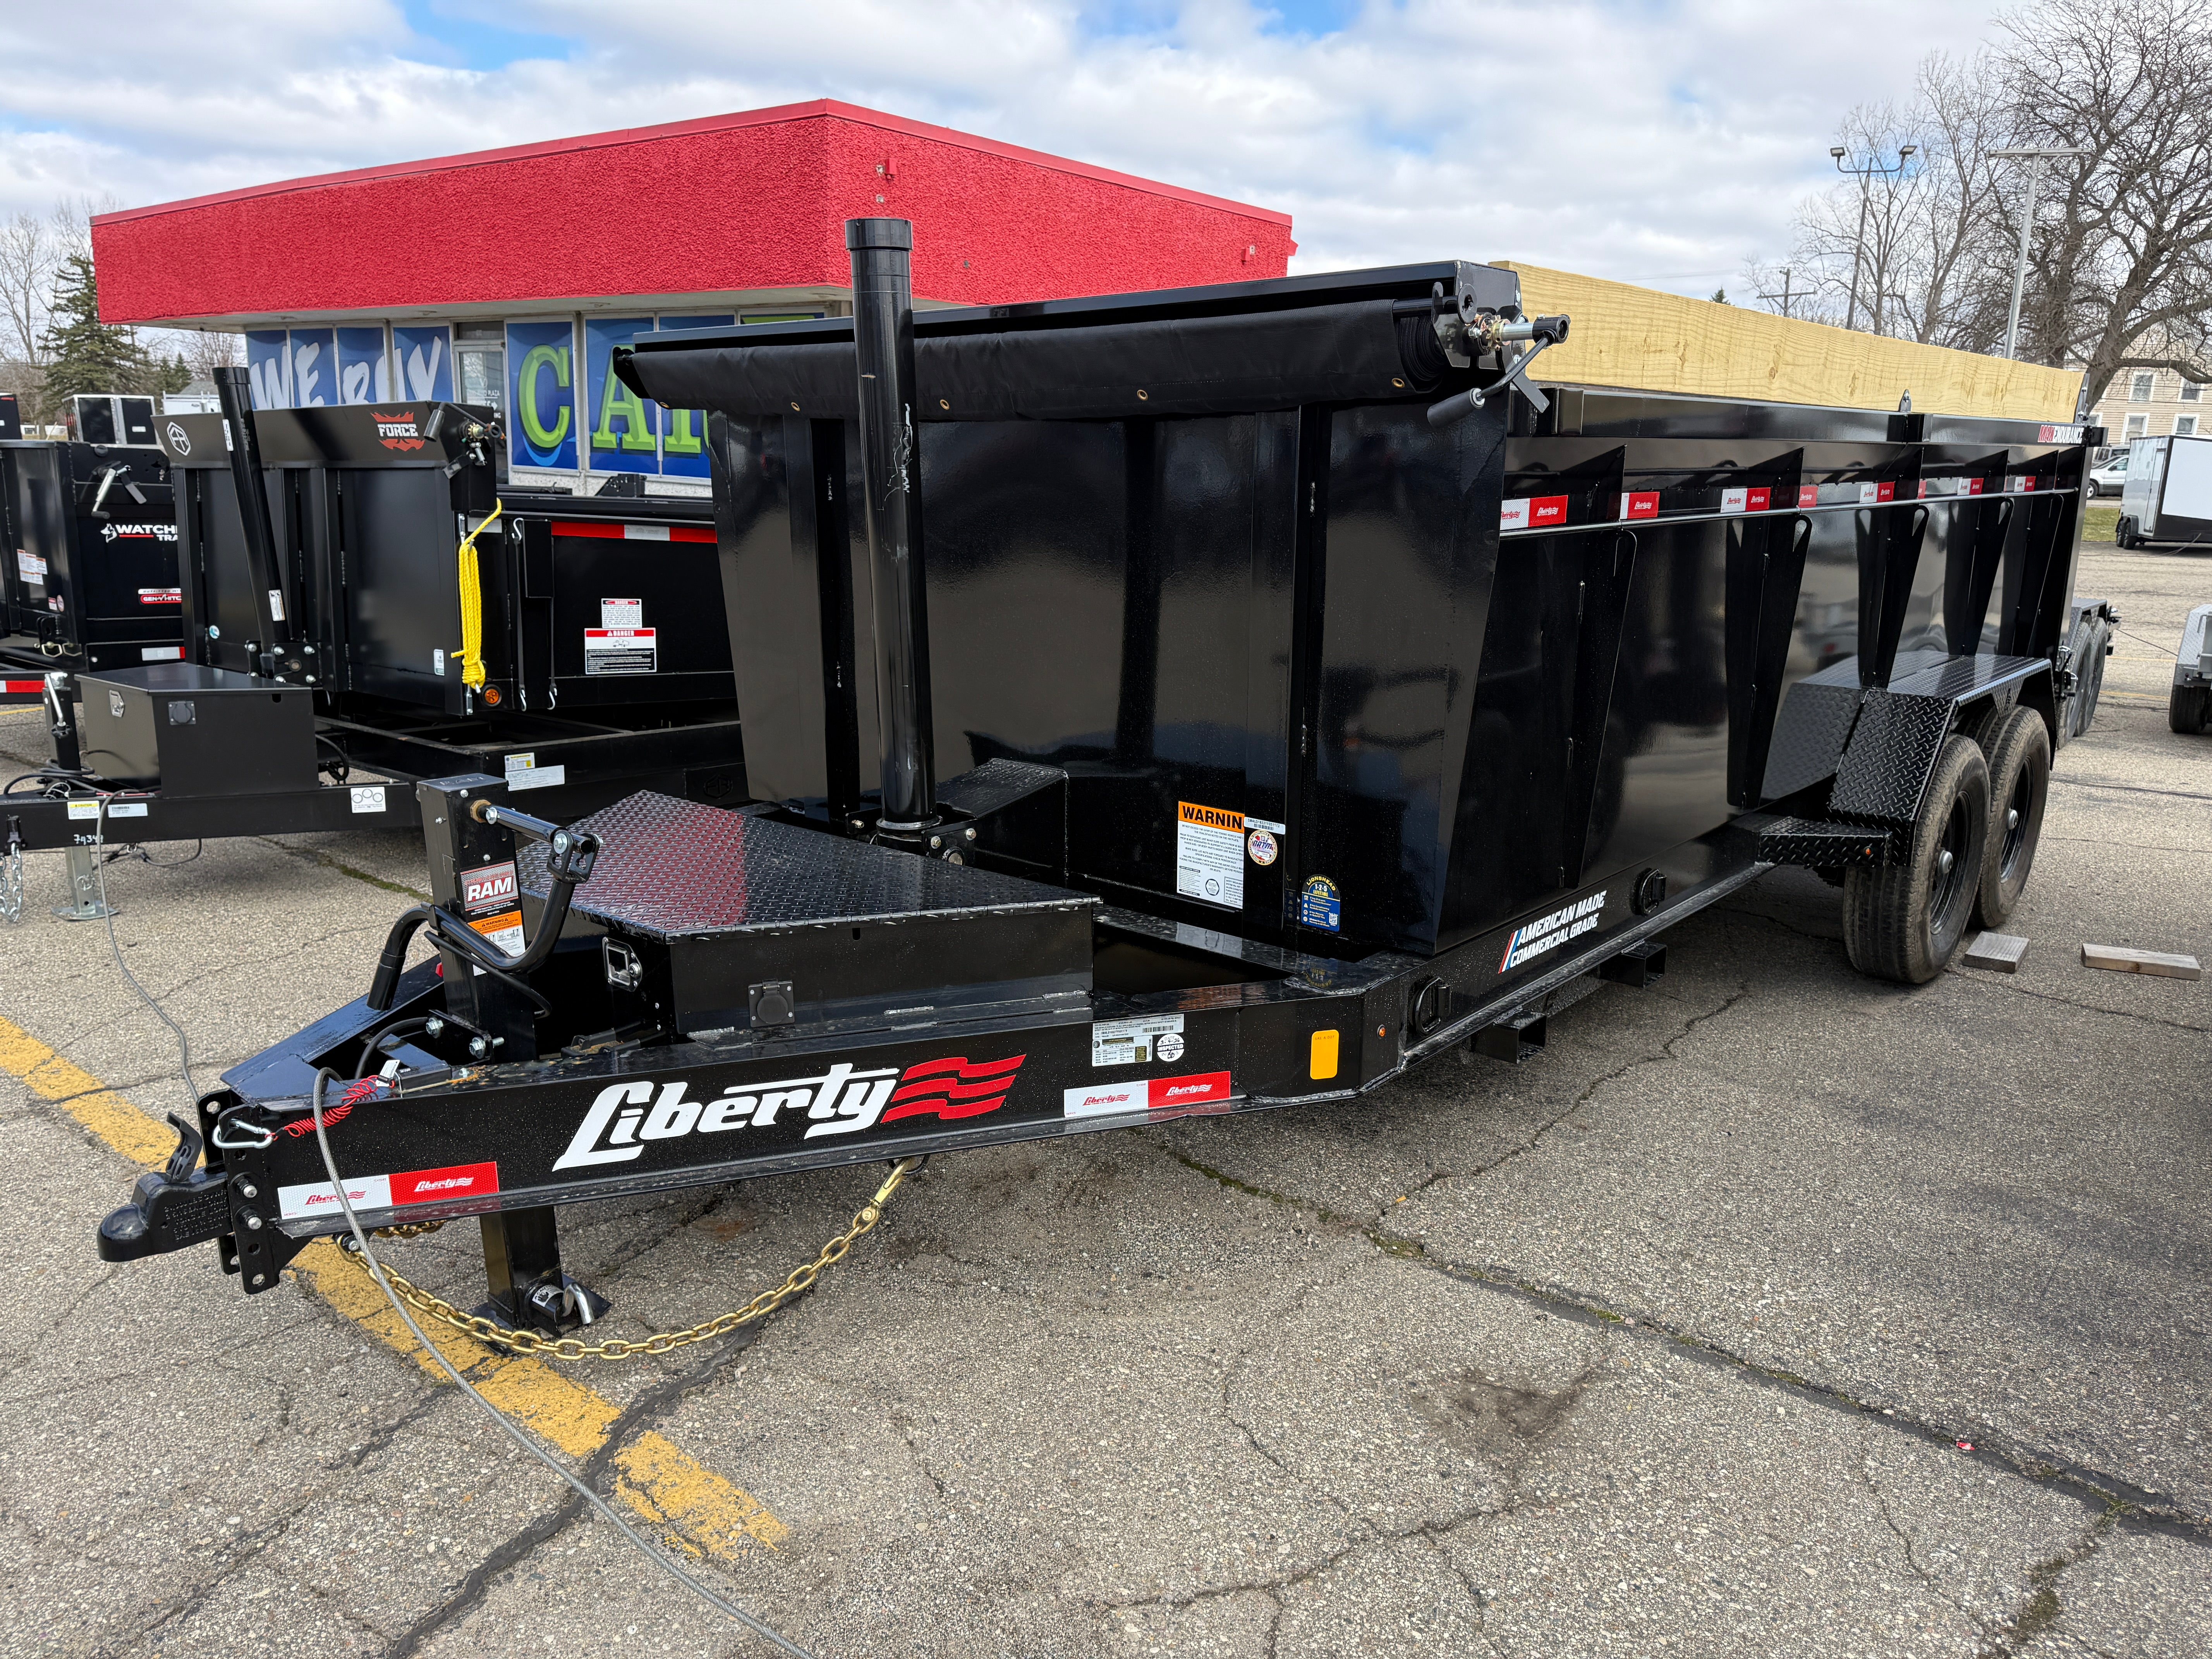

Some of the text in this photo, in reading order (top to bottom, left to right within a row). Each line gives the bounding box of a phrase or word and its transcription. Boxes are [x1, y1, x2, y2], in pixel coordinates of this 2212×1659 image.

[249, 342, 325, 409] WE
[378, 424, 418, 436] FORCE
[115, 525, 177, 534] WATCH
[468, 877, 512, 902] RAM
[1306, 876, 1336, 891] LIONSHEAD
[1517, 890, 1607, 946] AMERICAN MADE
[1510, 913, 1599, 968] COMMERCIAL GRADE
[1158, 1044, 1183, 1052] INSPECTED
[1165, 1085, 1200, 1096] Liberty
[1082, 1095, 1117, 1106] Liberty
[552, 1063, 900, 1172] Liberty
[414, 1179, 459, 1192] Liberty
